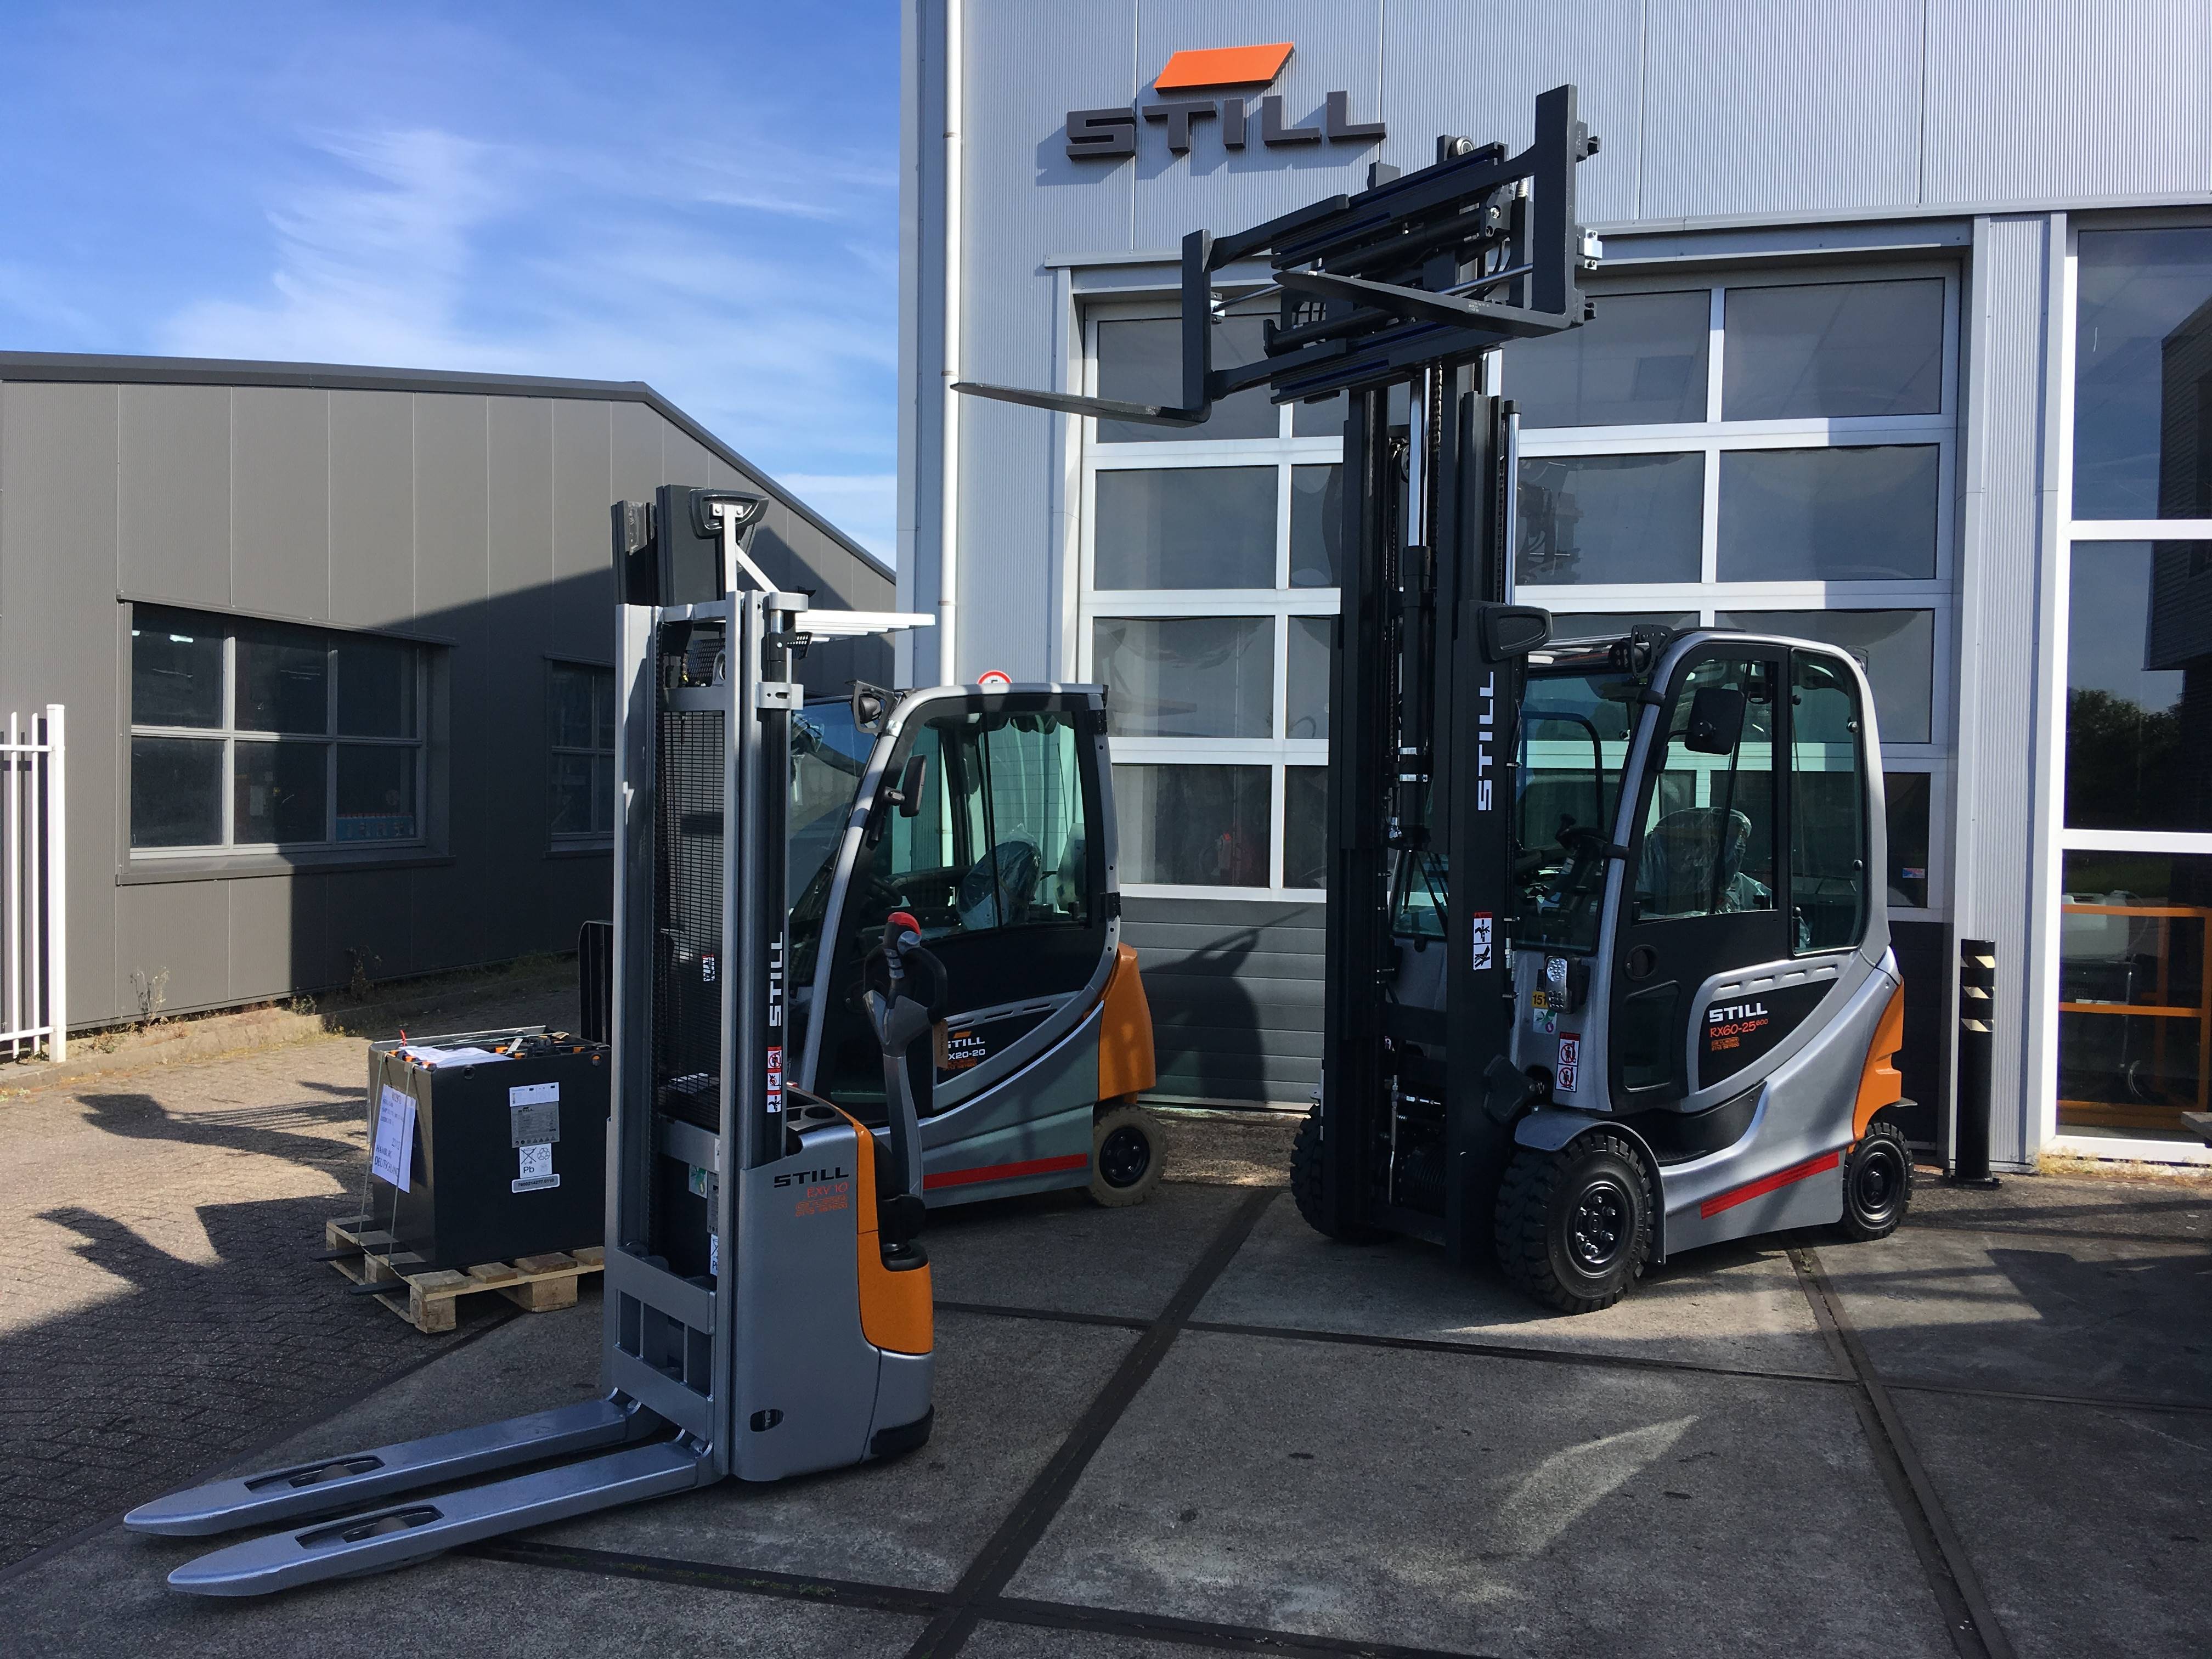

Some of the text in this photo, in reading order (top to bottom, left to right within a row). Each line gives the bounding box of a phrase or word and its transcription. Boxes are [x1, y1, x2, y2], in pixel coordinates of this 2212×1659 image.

[1066, 90, 1386, 160] STILL
[1478, 672, 1494, 811] STILL
[769, 932, 783, 1026] STILL
[1709, 1002, 1768, 1023] STILL
[947, 1037, 985, 1049] TILL
[948, 1048, 986, 1060] X20-20
[774, 1166, 850, 1188] STILL
